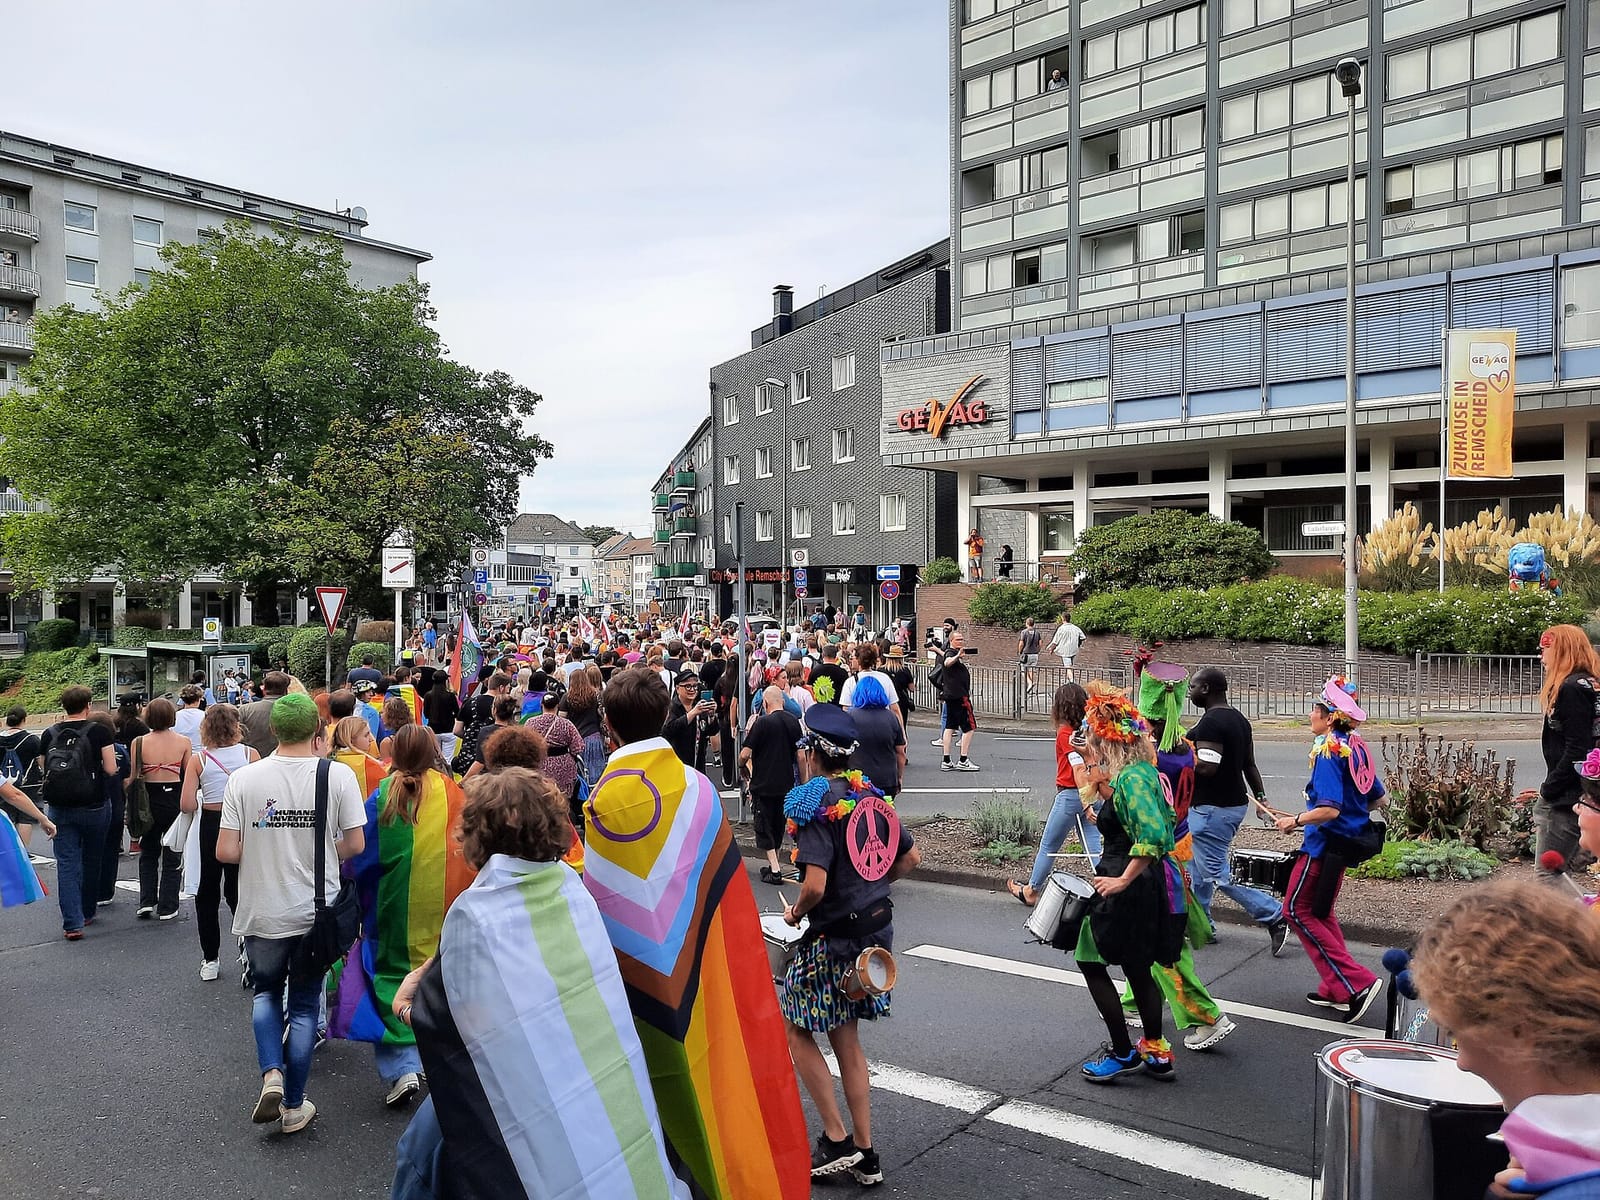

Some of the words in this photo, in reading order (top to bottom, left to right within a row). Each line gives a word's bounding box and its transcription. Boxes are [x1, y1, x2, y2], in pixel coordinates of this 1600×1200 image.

[1454, 380, 1469, 397] IN
[1471, 353, 1508, 368] GEWAG
[897, 374, 987, 439] GEWAG
[1453, 401, 1469, 471] ZUHAUSE
[1471, 381, 1488, 471] REMSCHEID
